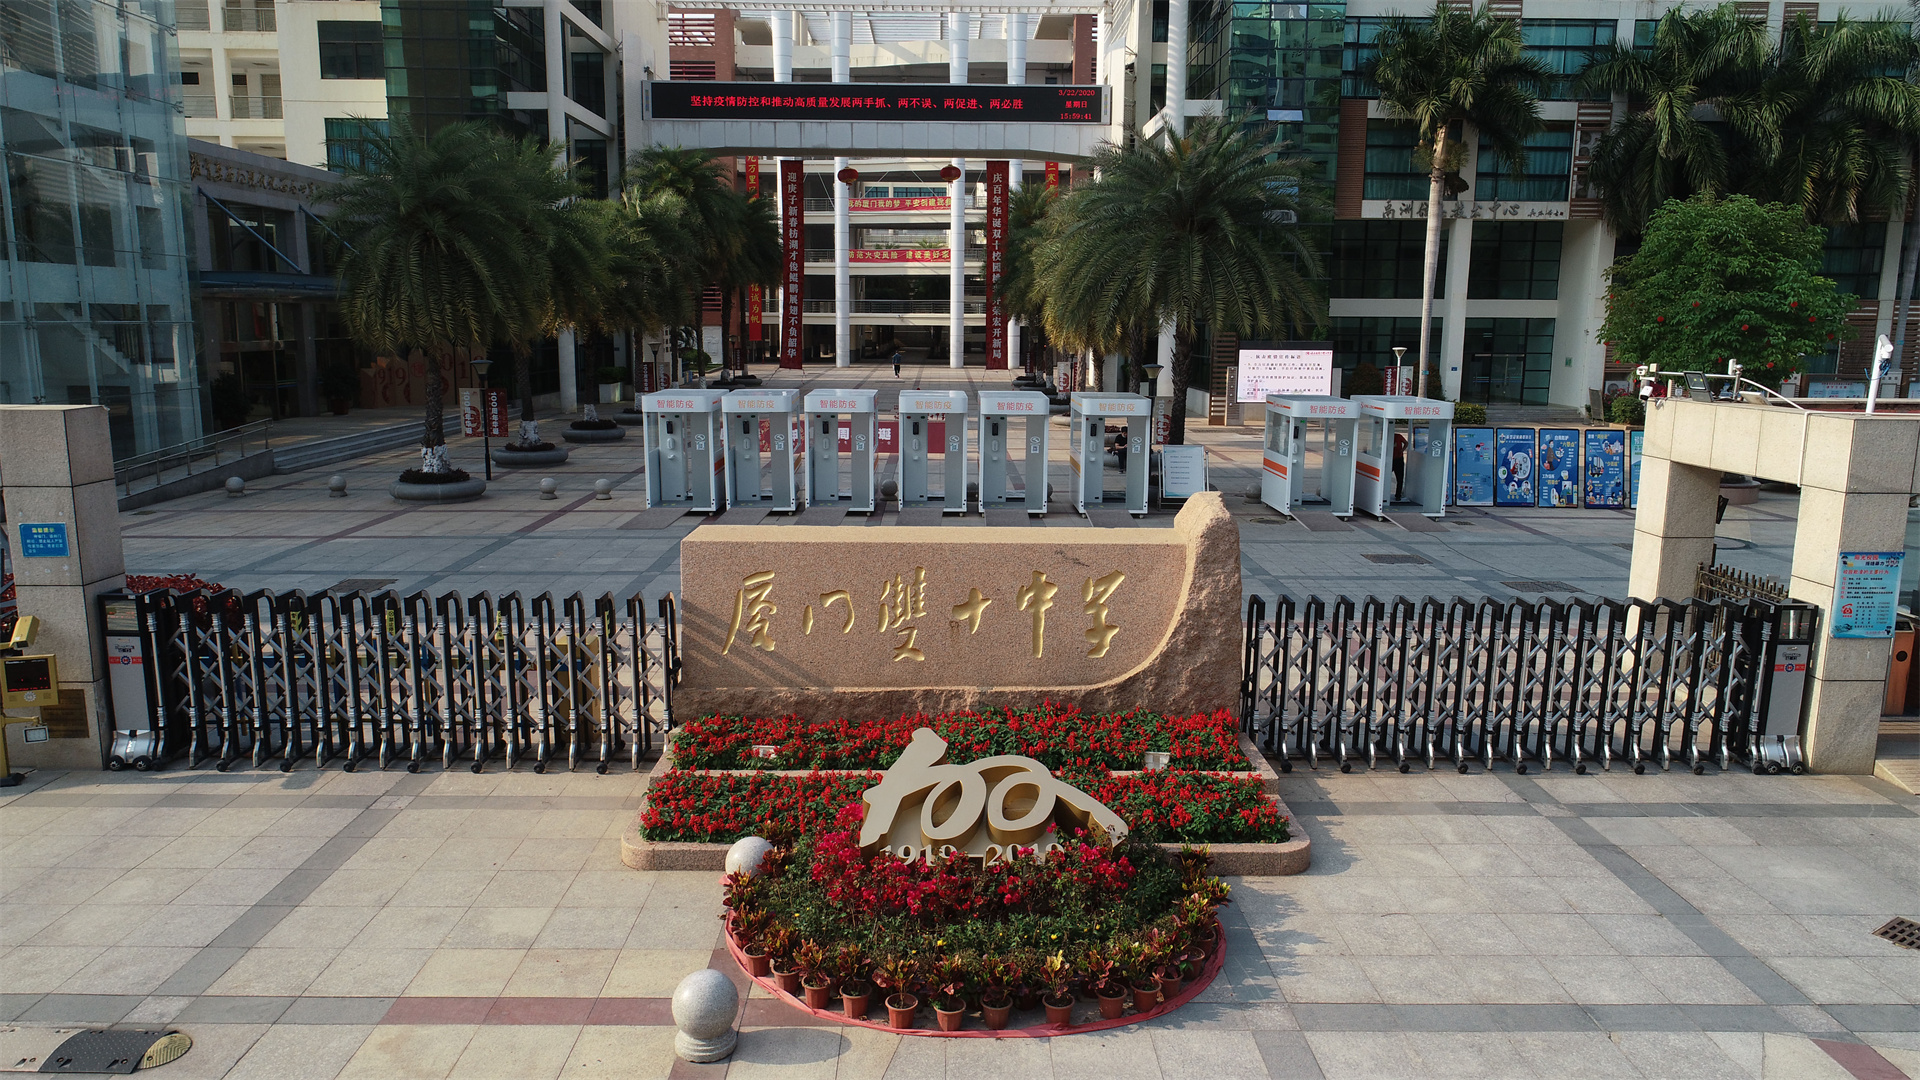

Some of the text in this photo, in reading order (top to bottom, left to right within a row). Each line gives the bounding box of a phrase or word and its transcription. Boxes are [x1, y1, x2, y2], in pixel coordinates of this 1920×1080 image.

[690, 95, 1024, 110] 坚持疫情防控和推动高质量发展两手抓、两不误、两促进、两必胜
[1065, 100, 1088, 109] 星期日
[1060, 112, 1092, 120] 15:59:41
[656, 399, 694, 409] 智能防疫
[737, 399, 775, 409] 智能防疫
[819, 399, 857, 409] 智能防疫
[914, 400, 952, 410] 智能防疫
[996, 401, 1034, 412] 智能防疫
[1098, 402, 1135, 412] 智能防疫
[1309, 404, 1347, 415] 智能防疫
[1404, 406, 1441, 416] 智能防疫
